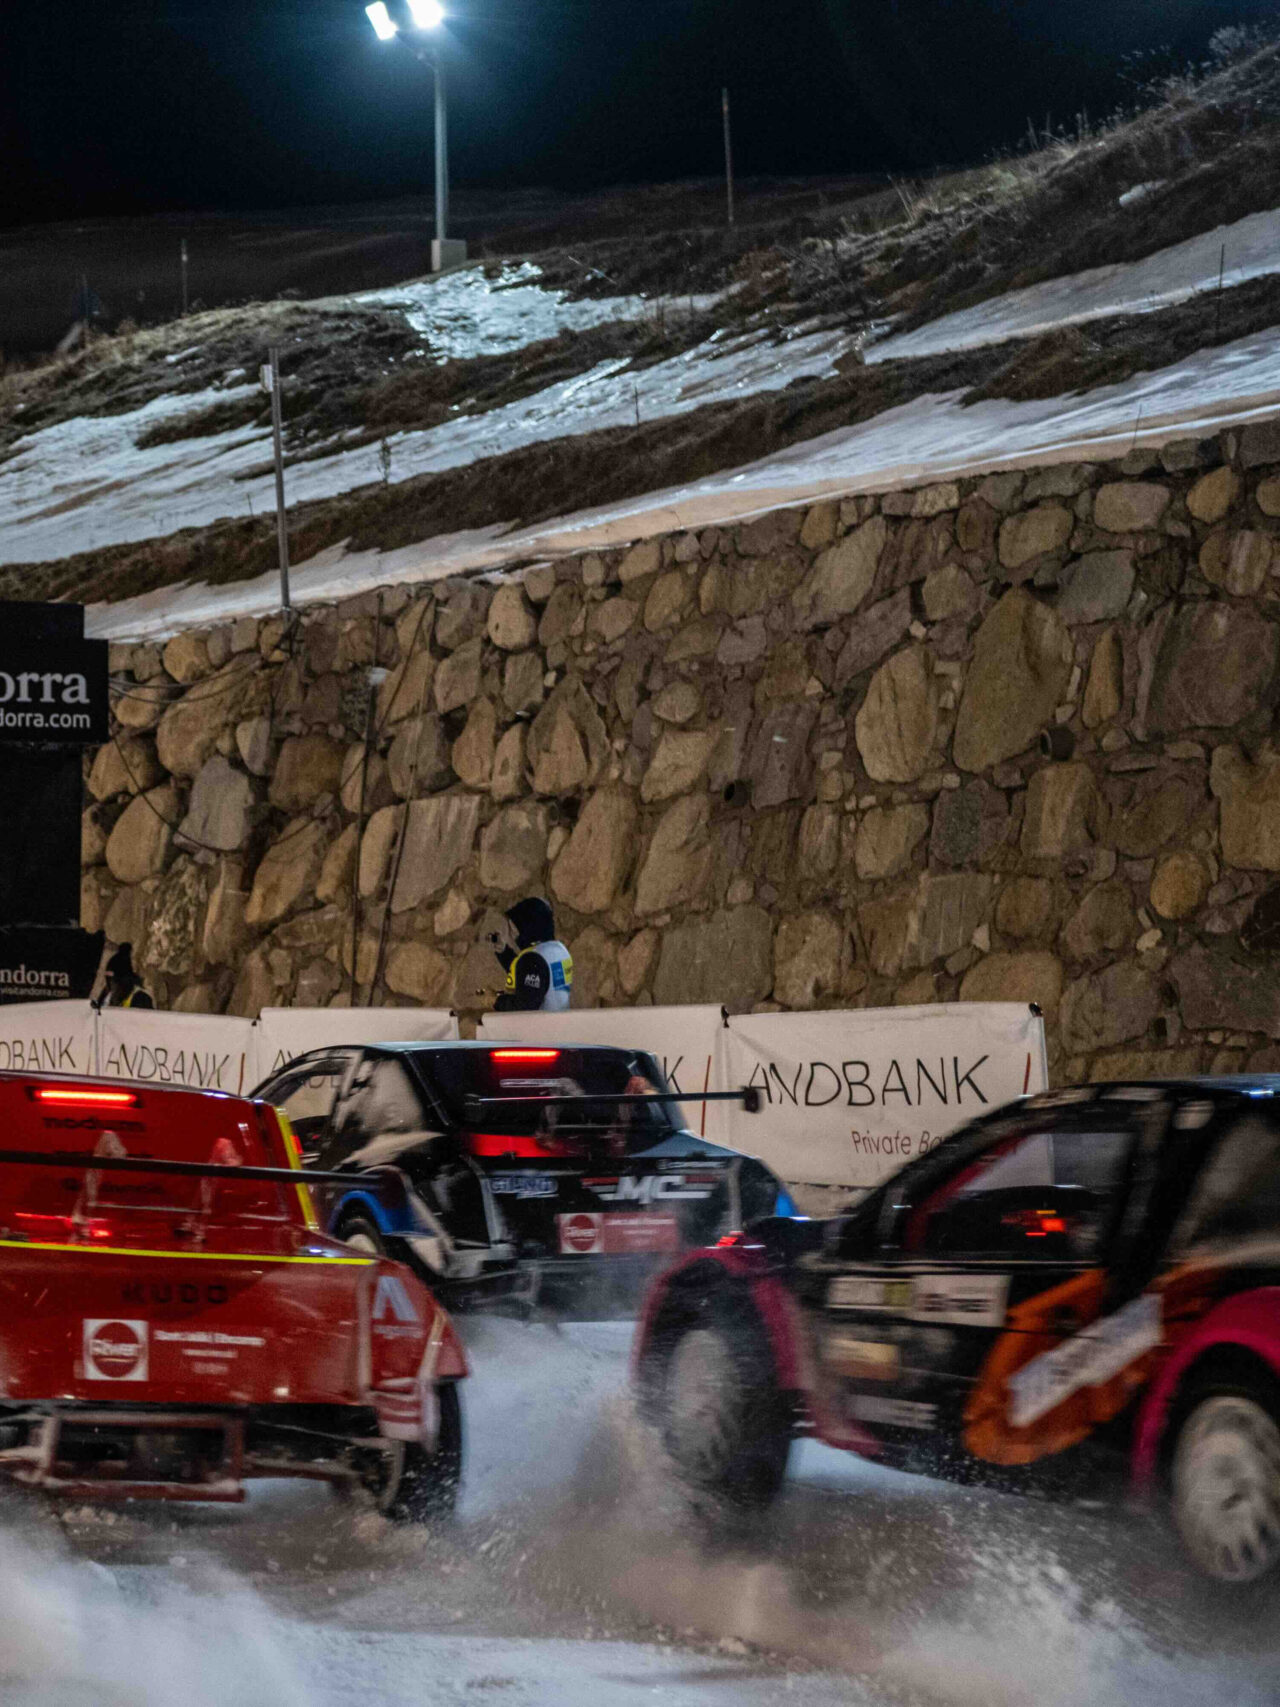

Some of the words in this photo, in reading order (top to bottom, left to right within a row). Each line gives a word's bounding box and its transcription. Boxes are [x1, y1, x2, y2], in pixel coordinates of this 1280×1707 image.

[0, 986, 70, 998] visitandorra.com
[748, 1055, 990, 1107] ANDBANK
[851, 1130, 912, 1155] Private
